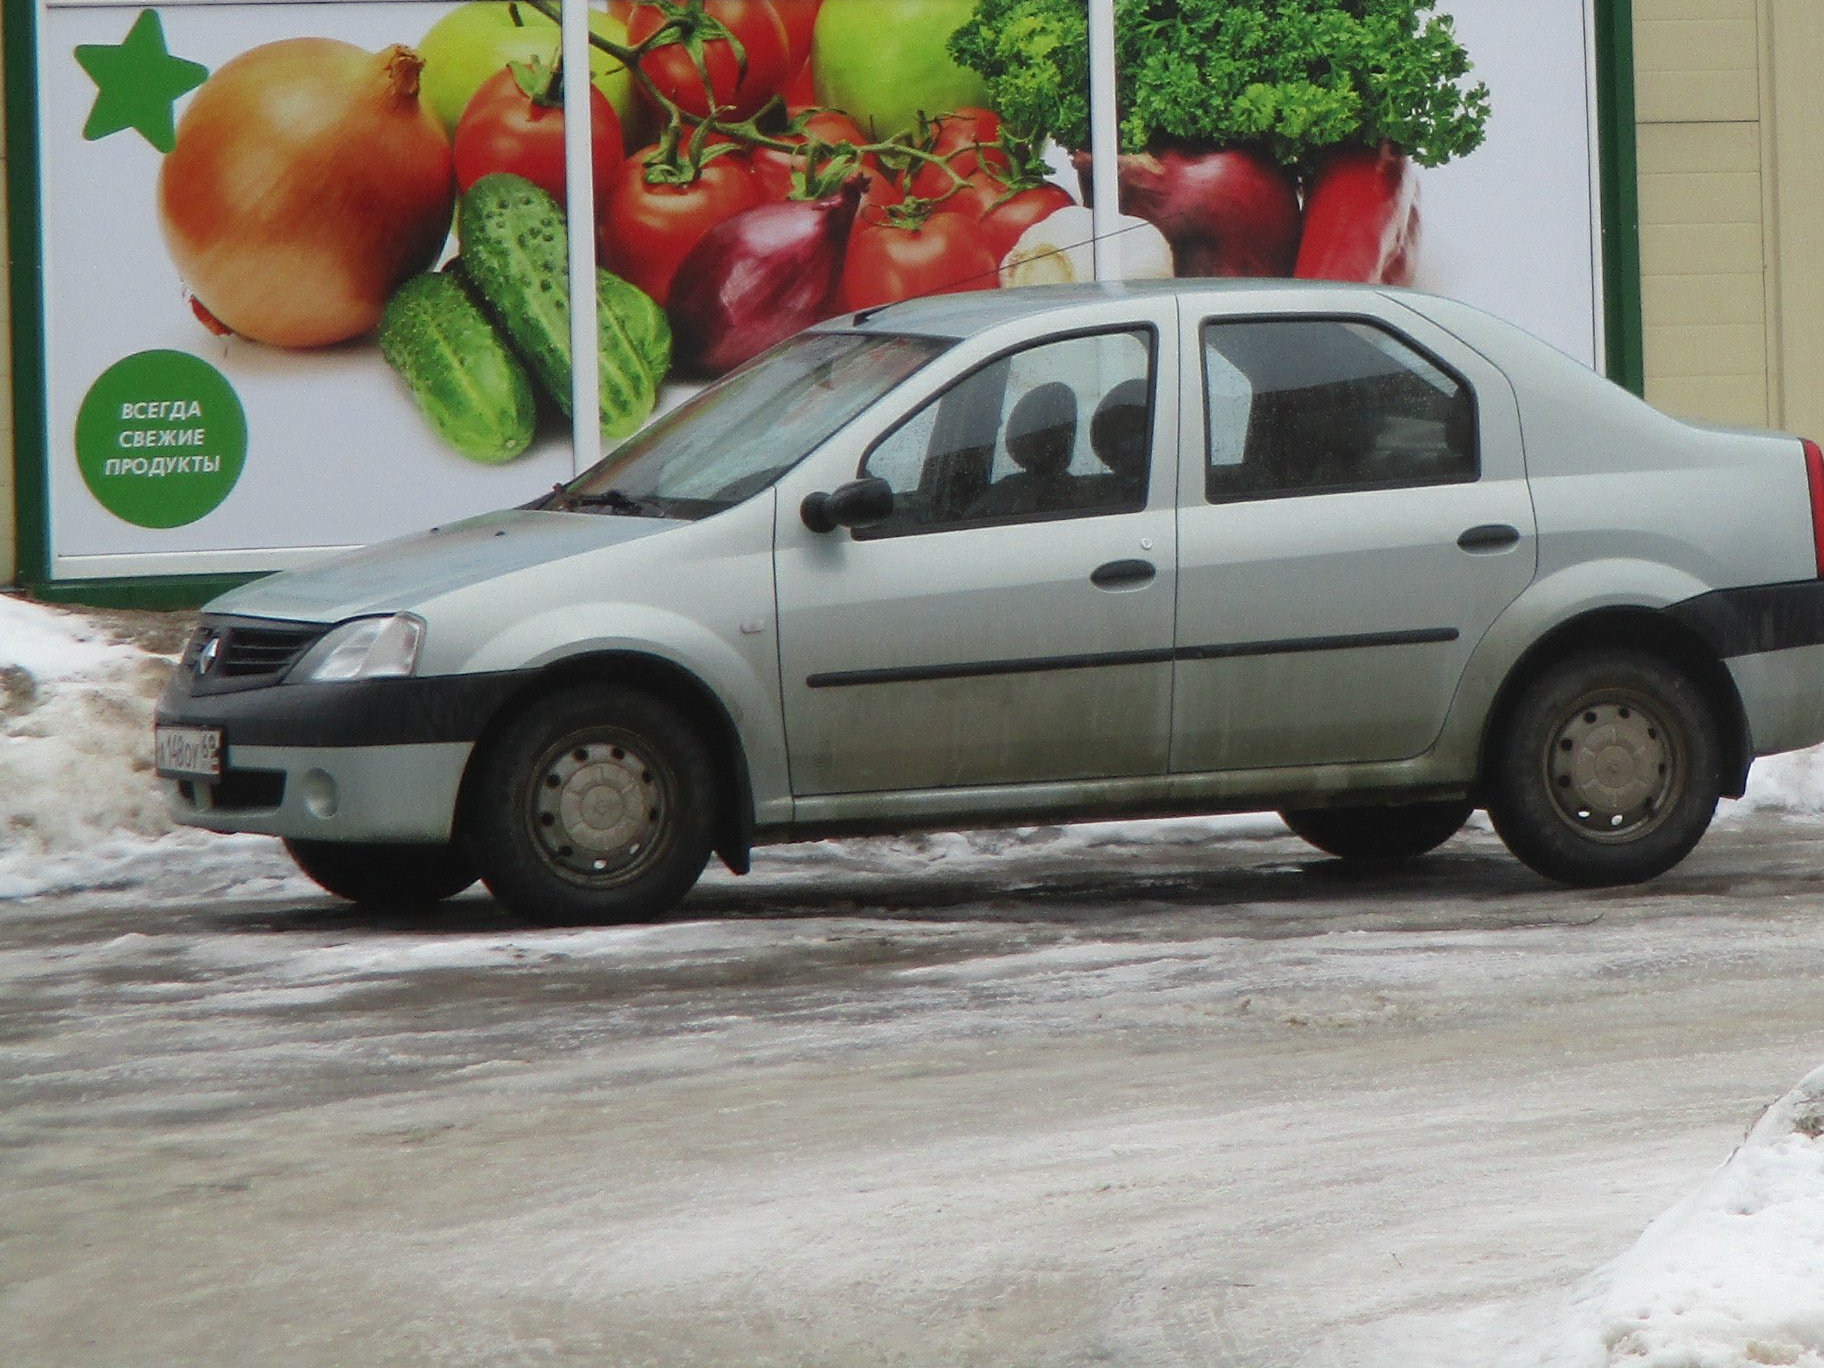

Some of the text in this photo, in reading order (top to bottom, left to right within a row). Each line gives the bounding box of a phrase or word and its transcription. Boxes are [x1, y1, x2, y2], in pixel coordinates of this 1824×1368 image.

[121, 400, 202, 421] ВСЕГДА
[119, 428, 205, 448] СВЕЖИЕ
[105, 455, 221, 478] ПРОДУКТЫ
